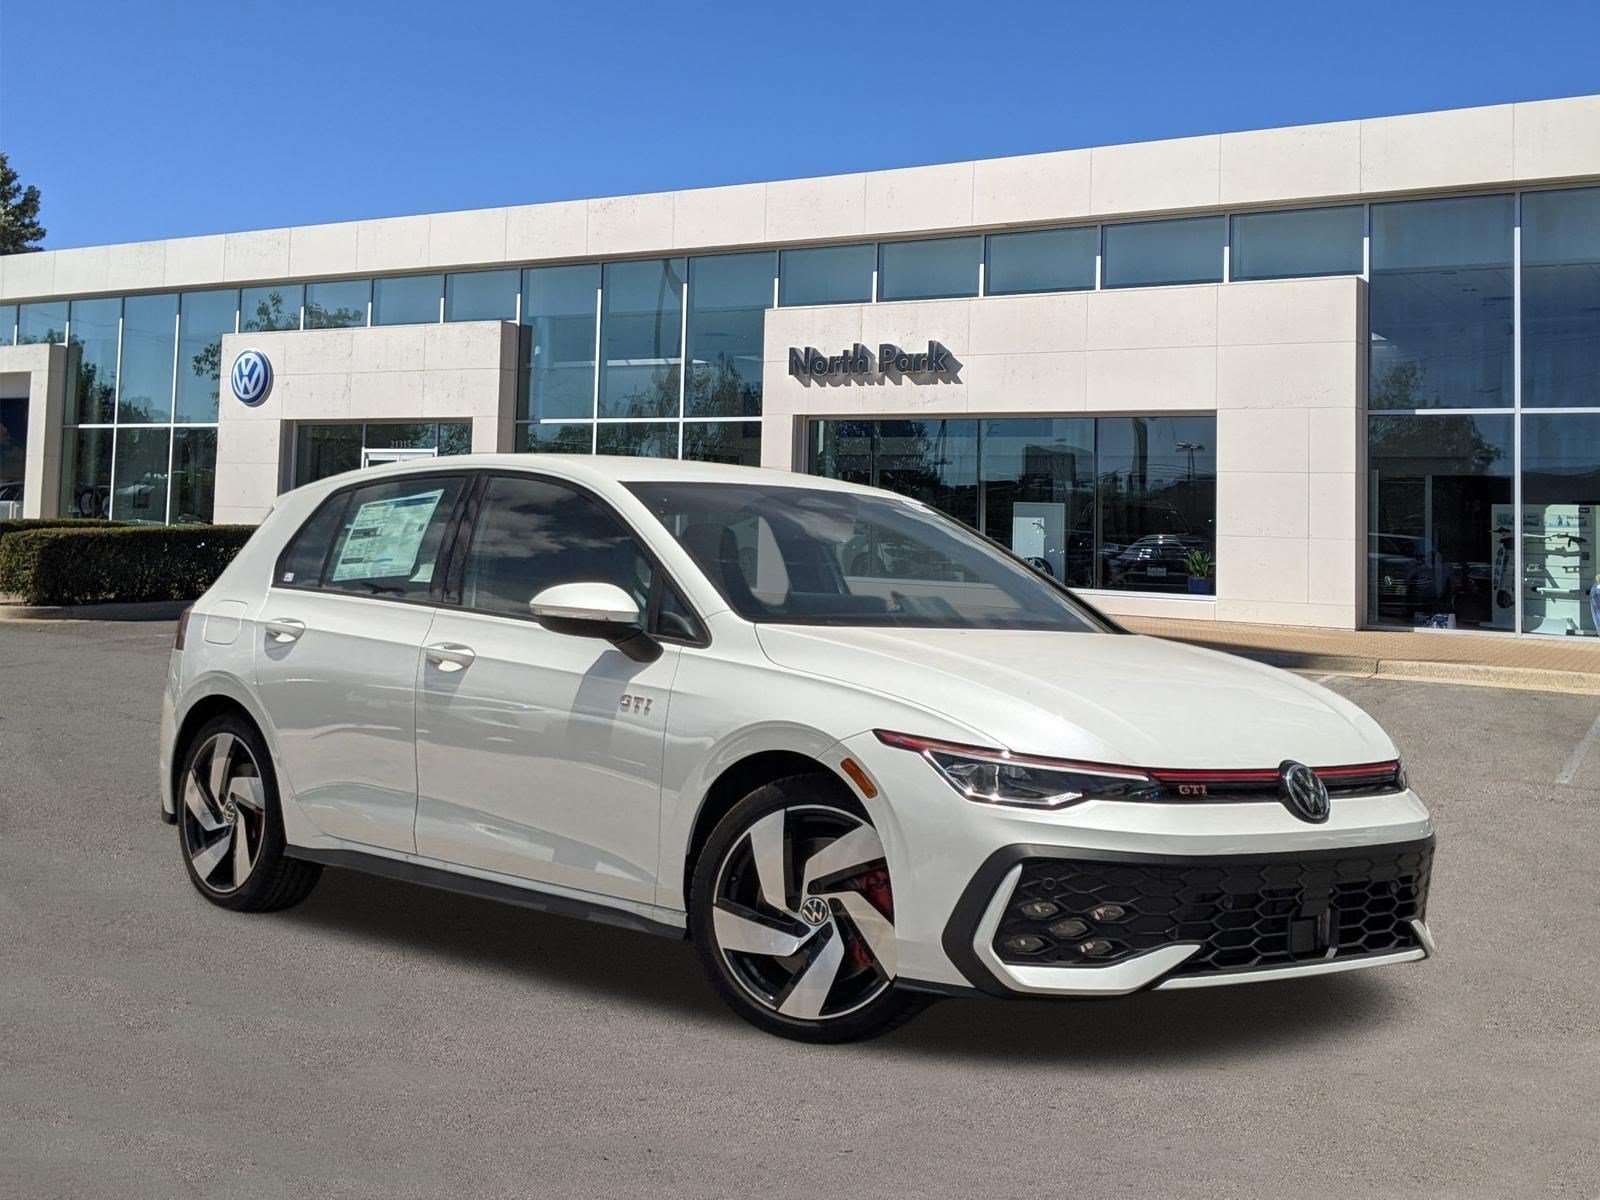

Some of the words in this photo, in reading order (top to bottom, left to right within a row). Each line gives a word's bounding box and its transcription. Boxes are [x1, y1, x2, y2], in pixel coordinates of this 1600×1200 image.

[788, 342, 871, 377] North
[878, 339, 949, 374] Park
[233, 352, 265, 400] VW
[620, 694, 653, 714] GTI
[1178, 784, 1208, 796] GTI
